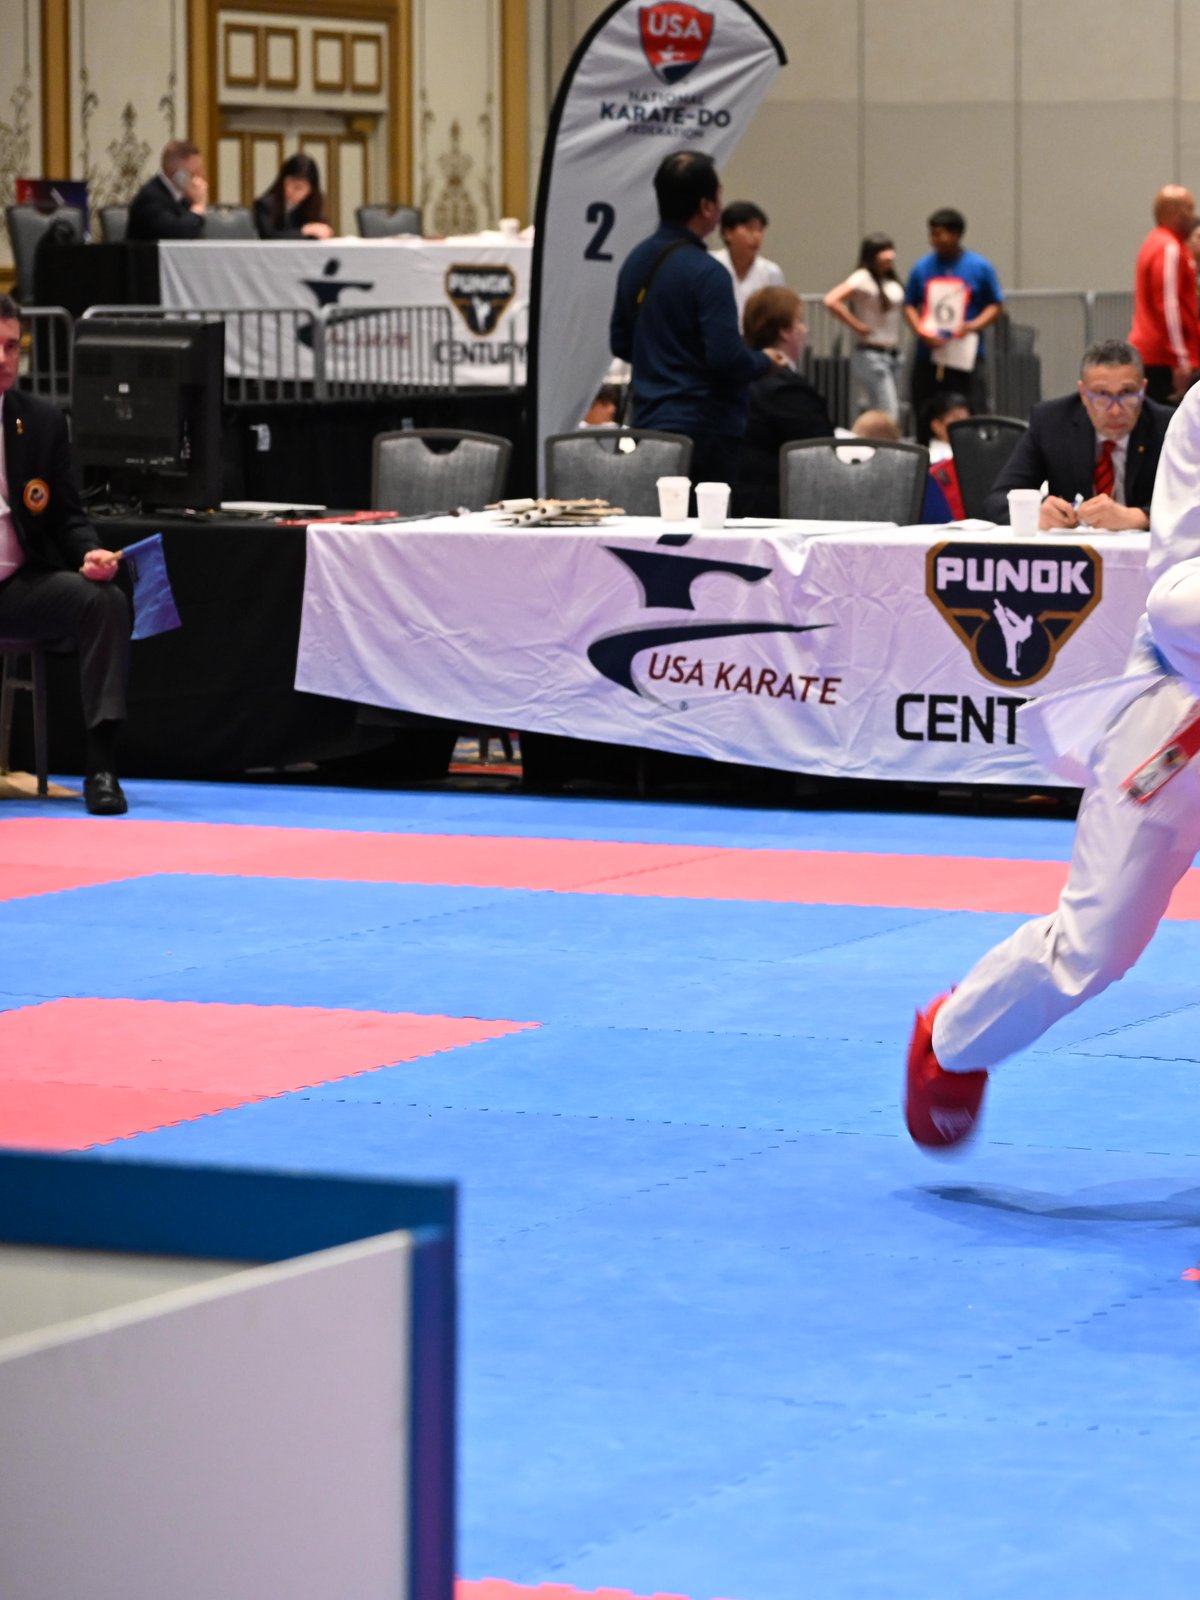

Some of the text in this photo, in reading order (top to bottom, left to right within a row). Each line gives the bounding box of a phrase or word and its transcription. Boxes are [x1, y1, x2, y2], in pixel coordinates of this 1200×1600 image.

[648, 12, 703, 41] USA
[600, 100, 731, 128] KARATE-DO
[628, 90, 704, 106] NATIONAL
[625, 124, 704, 139] FEDERATION
[583, 201, 616, 262] 2
[934, 291, 957, 325] 6
[936, 556, 1091, 596] PUNOK
[647, 652, 842, 705] USA KARATE
[895, 693, 1034, 745] CENT
